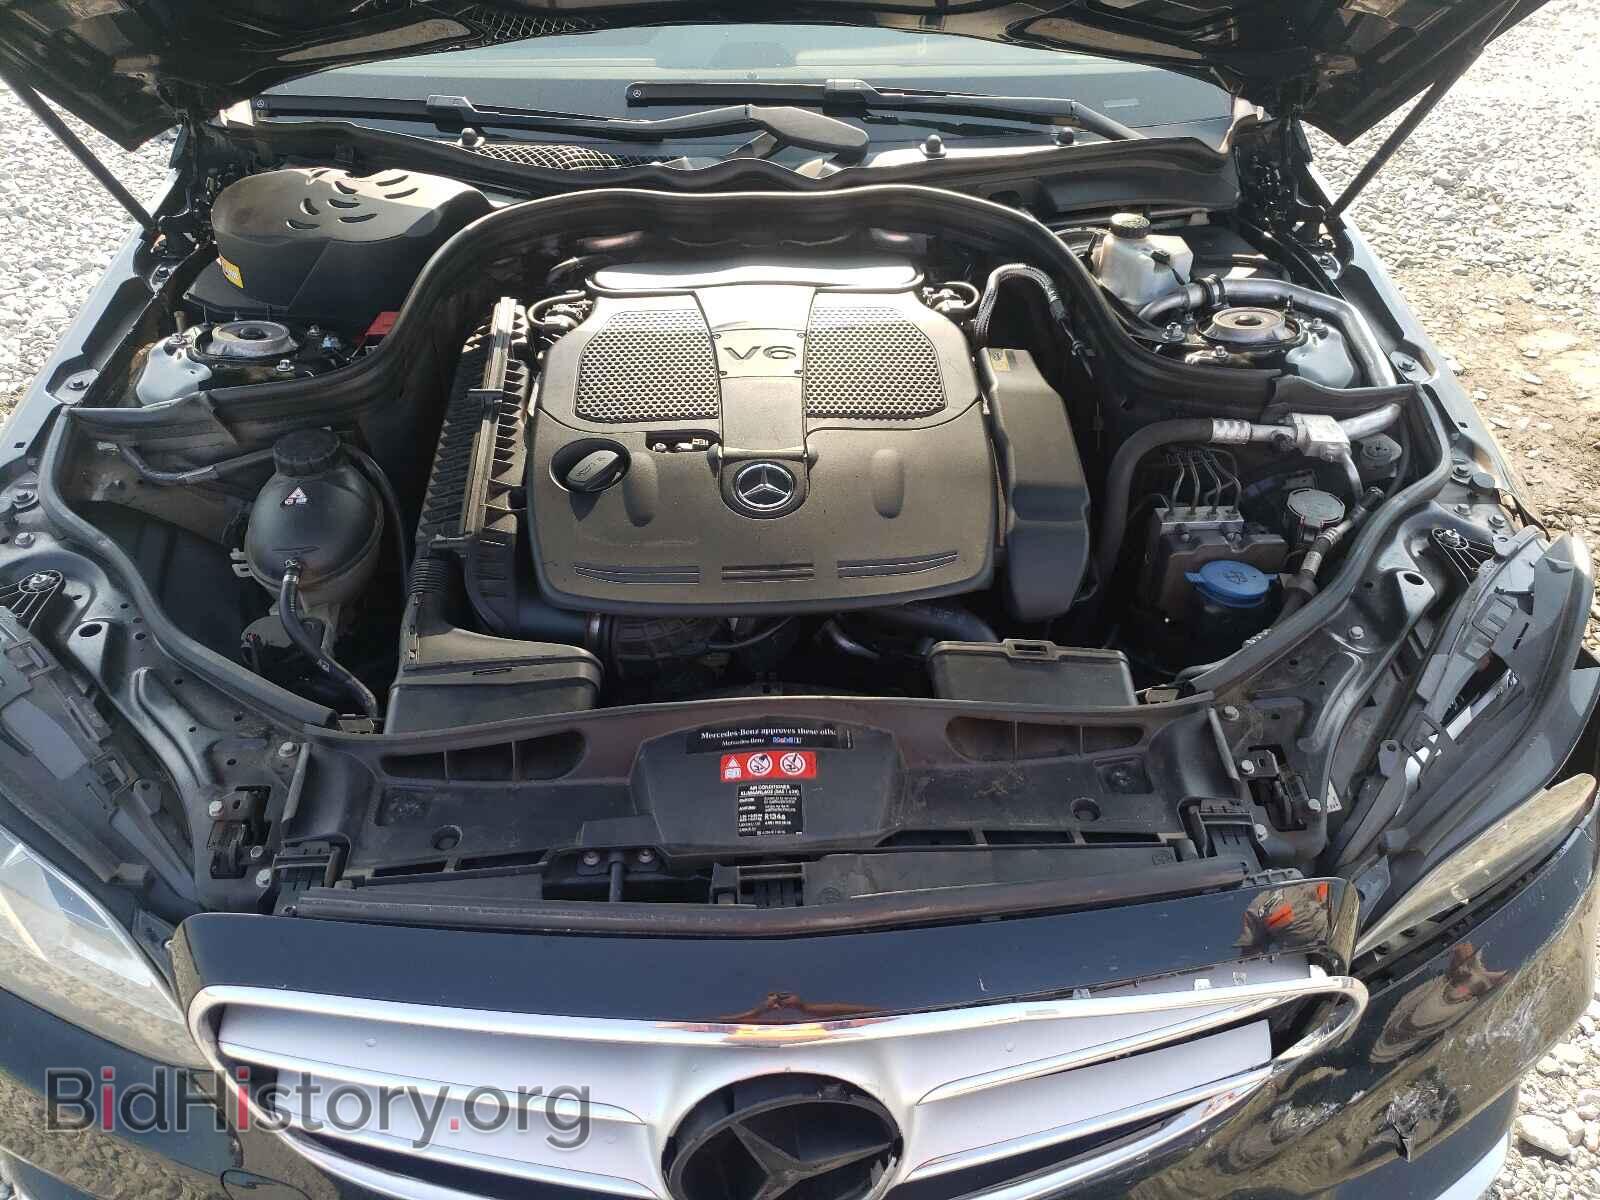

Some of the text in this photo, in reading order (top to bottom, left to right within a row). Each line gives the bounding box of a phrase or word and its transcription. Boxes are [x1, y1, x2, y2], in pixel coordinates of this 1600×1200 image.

[723, 346, 797, 360] V6
[701, 729, 759, 739] Mercedes-Benz
[761, 727, 796, 735] approves
[797, 727, 818, 735] these
